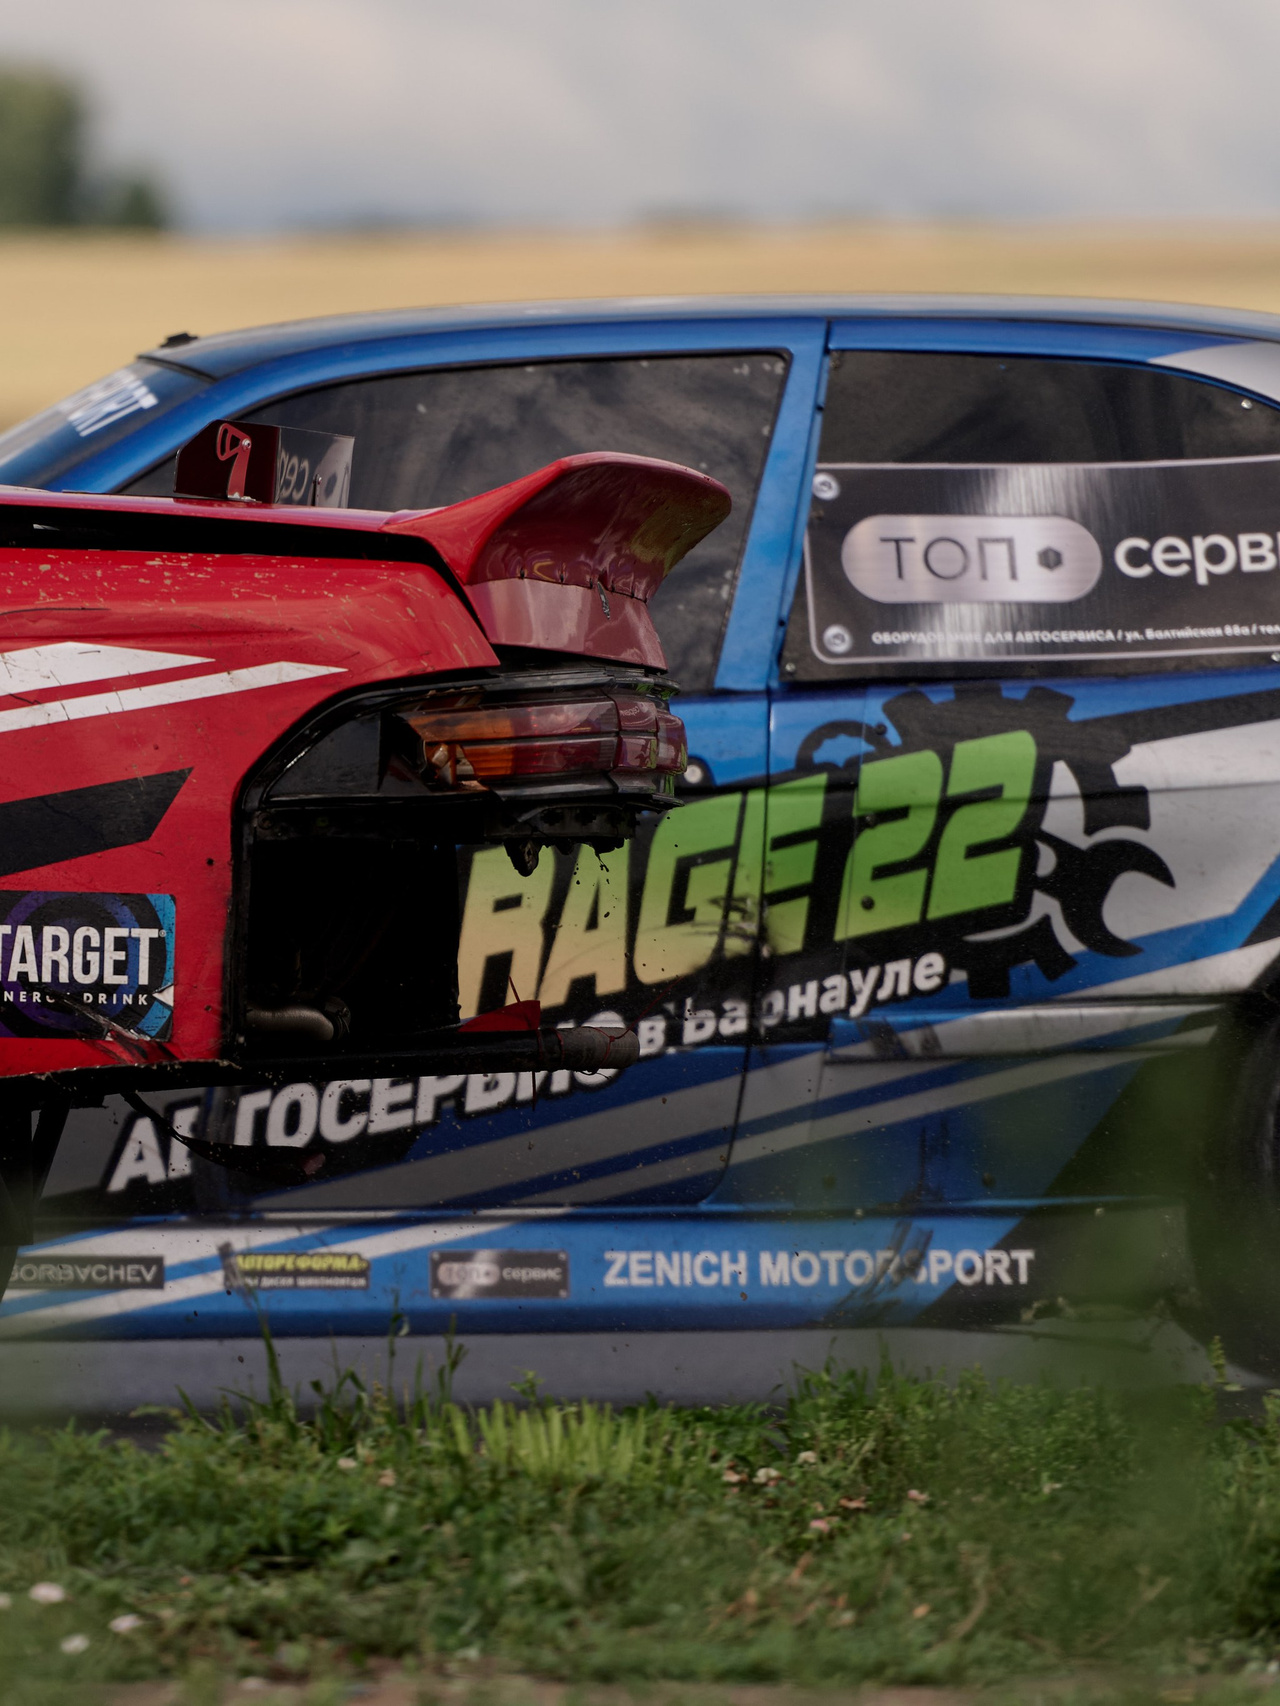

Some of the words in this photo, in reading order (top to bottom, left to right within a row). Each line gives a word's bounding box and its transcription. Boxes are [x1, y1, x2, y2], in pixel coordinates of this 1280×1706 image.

[879, 536, 1019, 581] ТОП
[1113, 532, 1280, 586] серв
[983, 631, 1014, 645] ДЛЯ
[1014, 629, 1116, 644] АВТОСЕРВИСА
[1144, 626, 1224, 641] Балтийская
[458, 772, 828, 1025] RAGE
[834, 730, 1037, 941] 22
[83, 993, 148, 1006] DRINK
[604, 1250, 749, 1287] ZENICH
